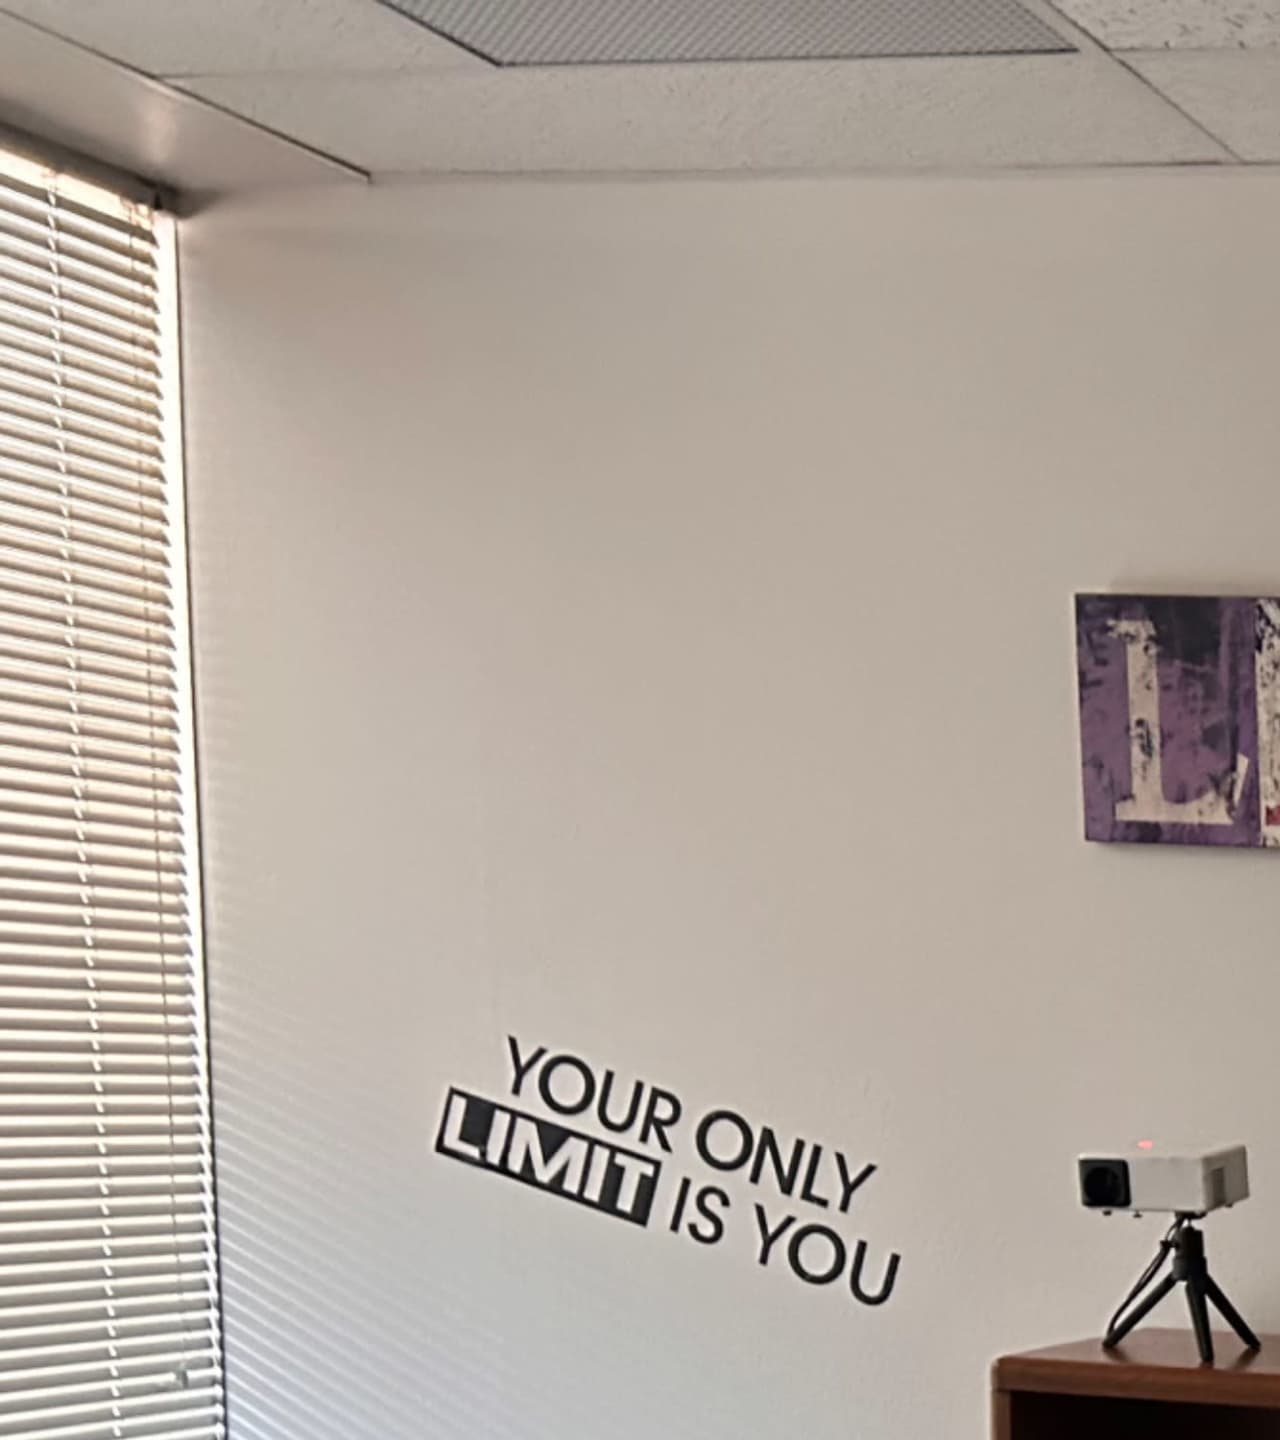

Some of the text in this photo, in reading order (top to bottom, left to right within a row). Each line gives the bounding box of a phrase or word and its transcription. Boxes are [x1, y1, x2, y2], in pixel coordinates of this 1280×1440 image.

[442, 1093, 901, 1306] LIMIT IS YOU
[508, 1034, 877, 1214] YOUR ONLY
